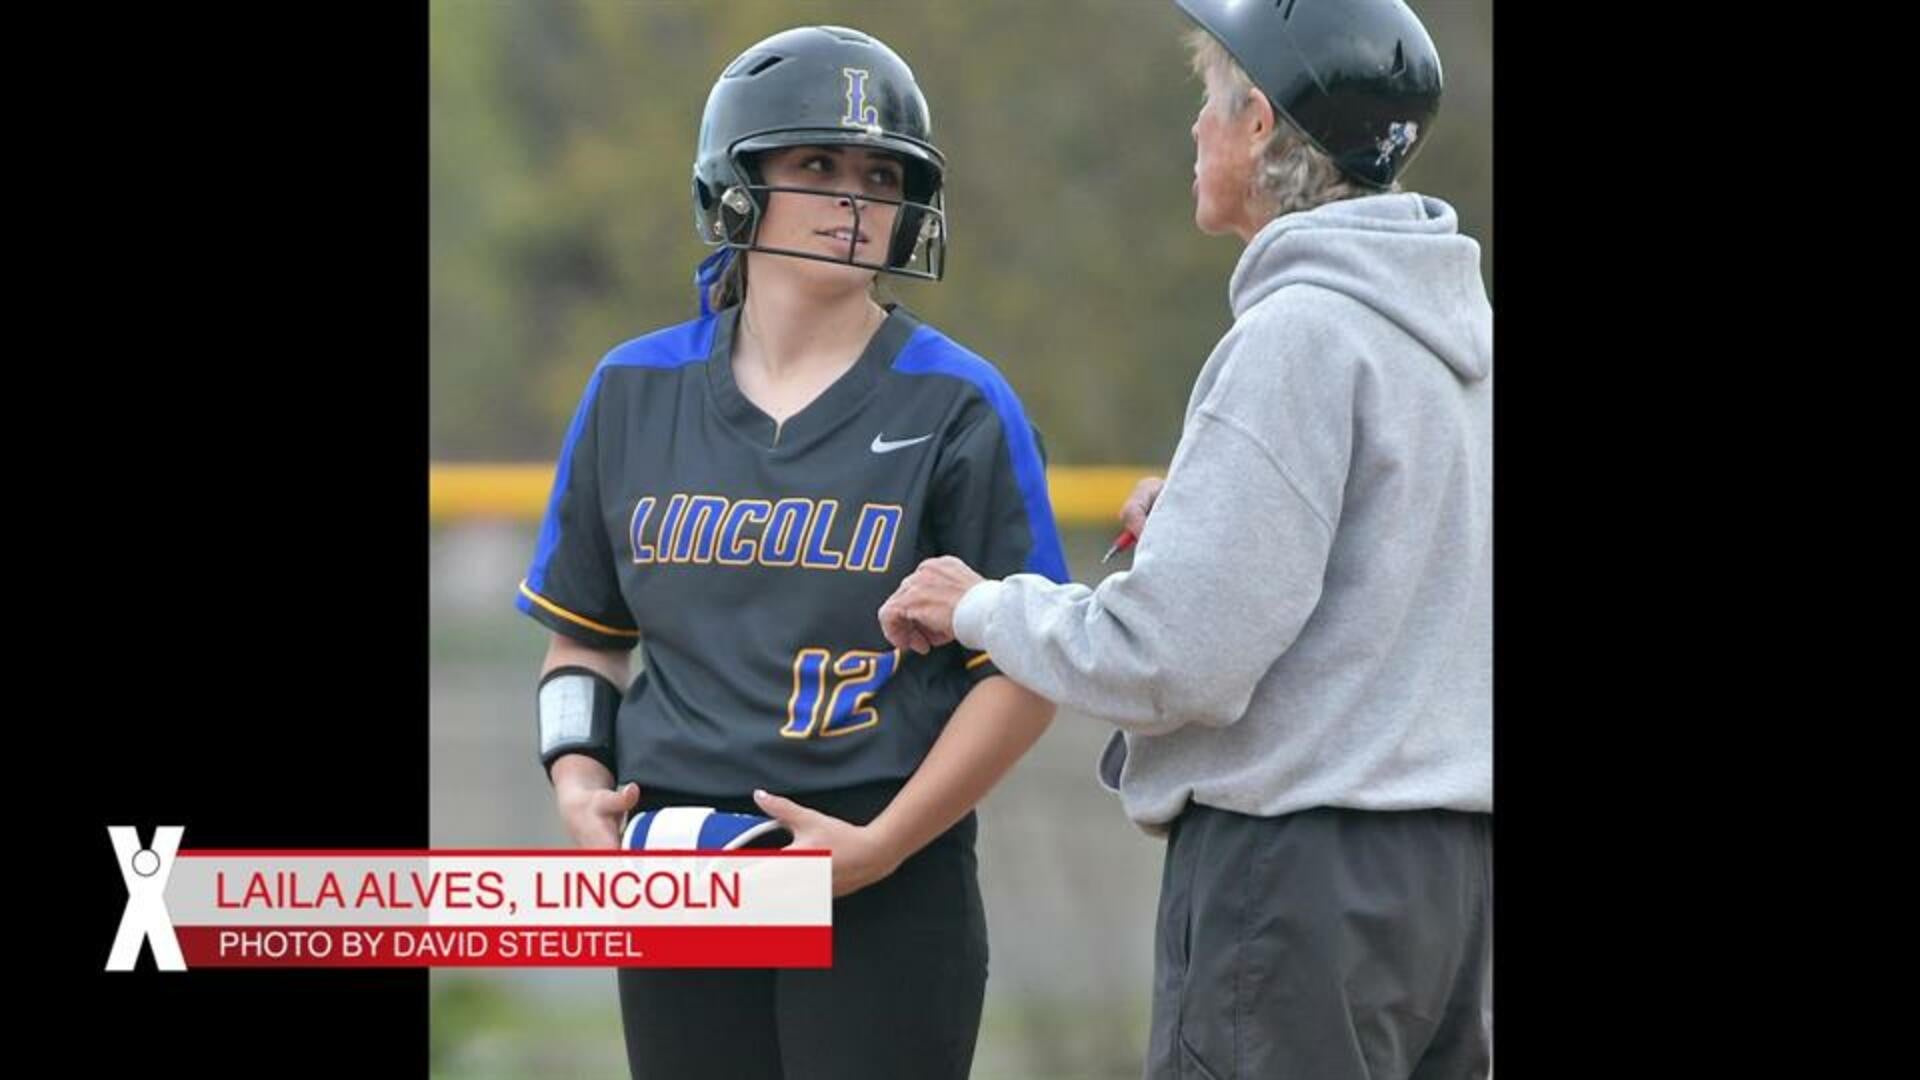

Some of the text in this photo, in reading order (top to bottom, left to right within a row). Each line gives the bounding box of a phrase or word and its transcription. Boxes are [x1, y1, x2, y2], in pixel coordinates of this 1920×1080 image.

[842, 67, 880, 133] L
[630, 494, 902, 573] LINCOLN
[780, 648, 899, 739] 12
